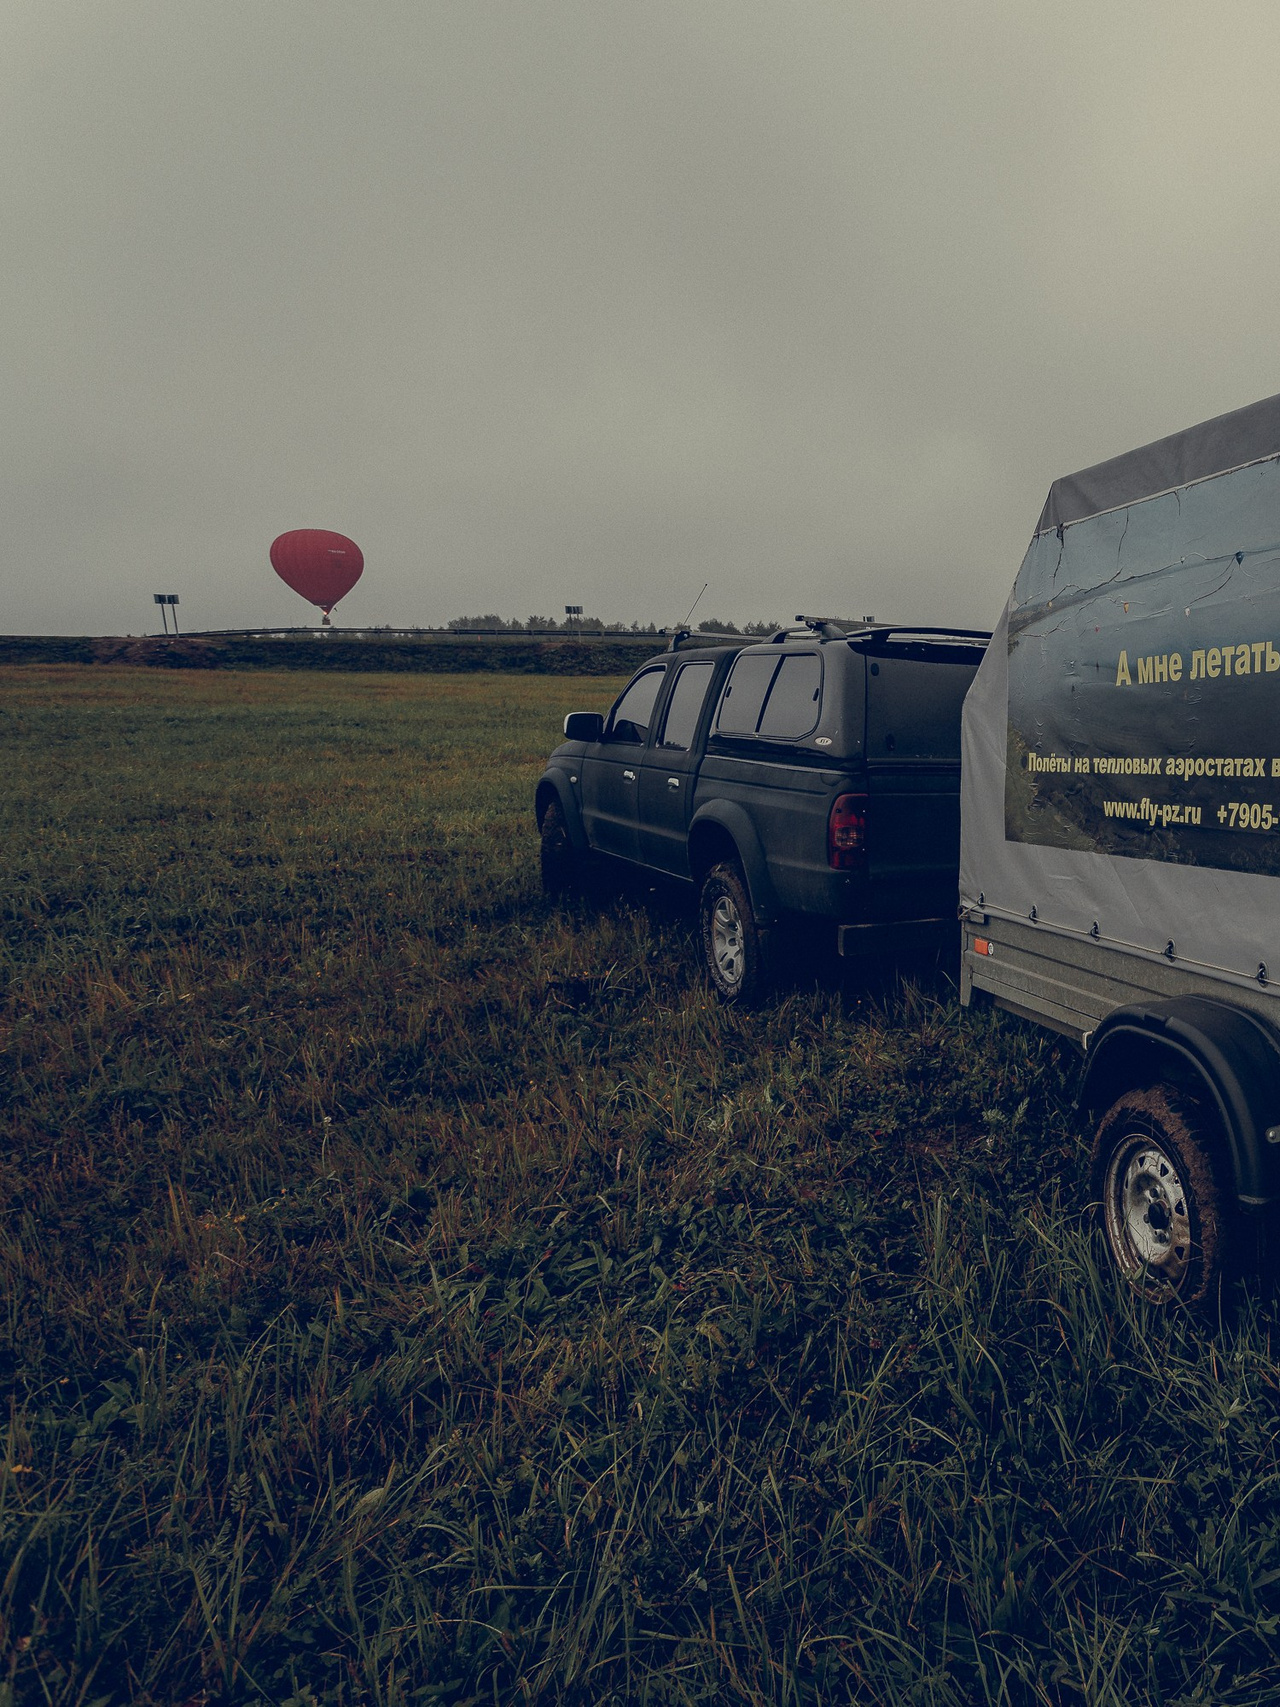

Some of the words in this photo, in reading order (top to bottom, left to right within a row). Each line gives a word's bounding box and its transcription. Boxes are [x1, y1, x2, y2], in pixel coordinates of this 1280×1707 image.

[1115, 650, 1132, 687] А
[1137, 652, 1183, 684] мне
[1028, 752, 1071, 774] Полёты
[1074, 757, 1090, 774] на
[1093, 757, 1162, 775] тепловых
[1165, 757, 1266, 782] аэростатах
[1103, 797, 1202, 827] www.fly-pz.ru
